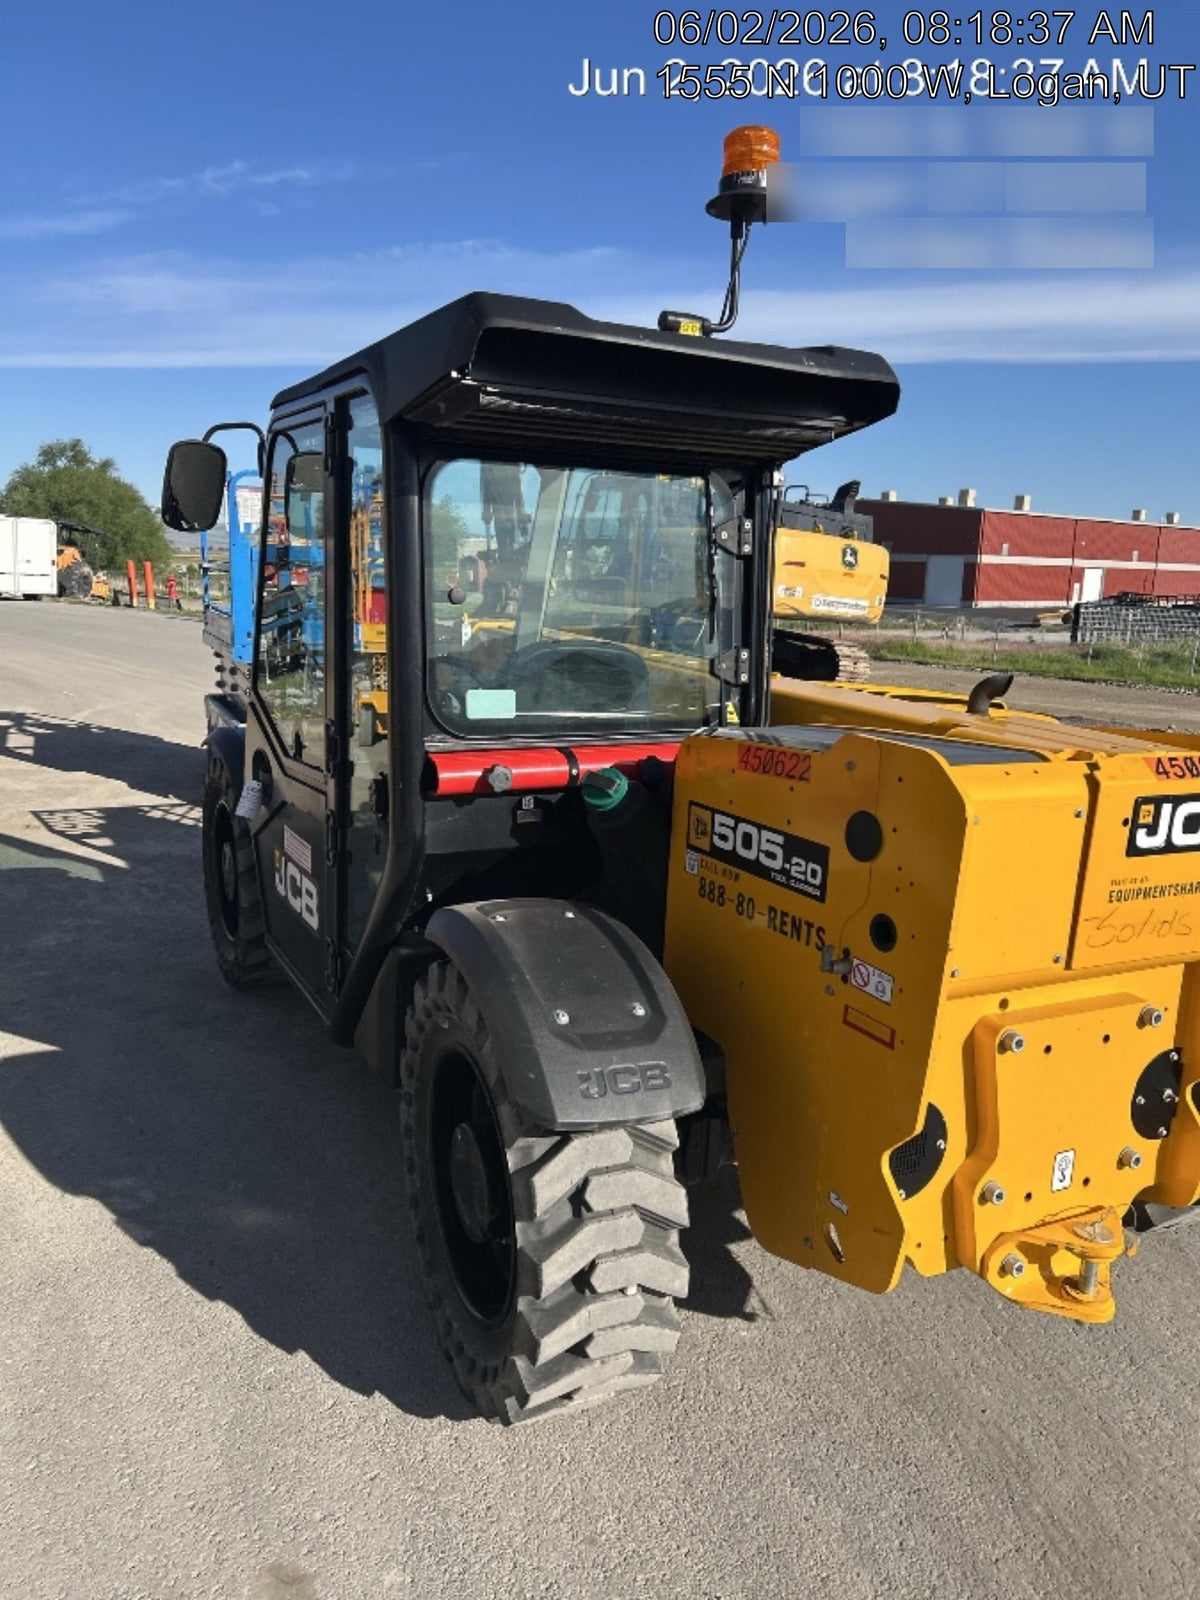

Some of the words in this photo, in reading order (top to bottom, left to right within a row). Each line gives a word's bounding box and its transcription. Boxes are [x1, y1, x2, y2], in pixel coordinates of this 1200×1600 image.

[739, 745, 812, 782] 450622
[1155, 756, 1200, 779] 450
[274, 856, 319, 930] JCB
[698, 876, 826, 952] 888-80-RENTS
[578, 1060, 673, 1099] JCB
